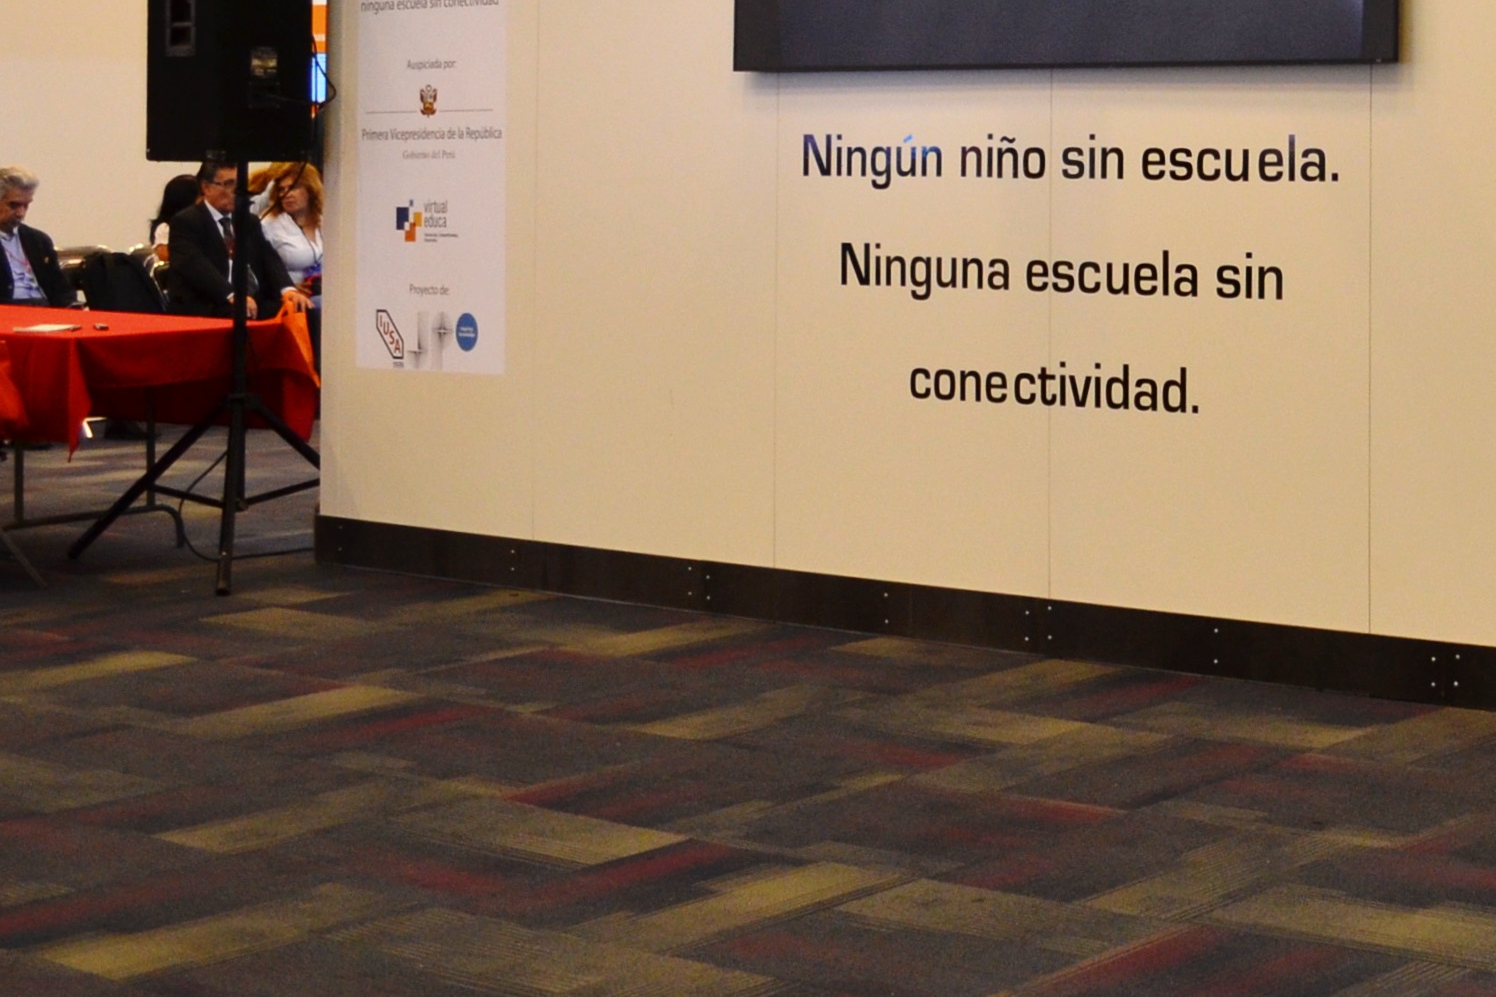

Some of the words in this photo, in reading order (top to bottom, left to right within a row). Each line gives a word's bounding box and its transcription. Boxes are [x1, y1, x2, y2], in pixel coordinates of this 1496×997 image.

[361, 0, 395, 15] ninguna
[362, 128, 389, 141] Primera
[390, 126, 445, 143] Vicepresidencia
[447, 126, 457, 140] de
[458, 126, 464, 140] la
[466, 125, 502, 142] República
[802, 134, 942, 190] Ningún
[960, 135, 1046, 180] niño
[1061, 134, 1125, 180] sin
[1141, 134, 1340, 182] escuela.
[424, 200, 448, 214] virtual
[424, 215, 447, 228] educa
[840, 242, 1010, 300] Ninguna
[1026, 250, 1199, 297] escuela
[1215, 252, 1284, 300] sin
[409, 284, 438, 297] Proyecto
[379, 315, 401, 353] IUSA
[910, 361, 1200, 414] conectividad.
